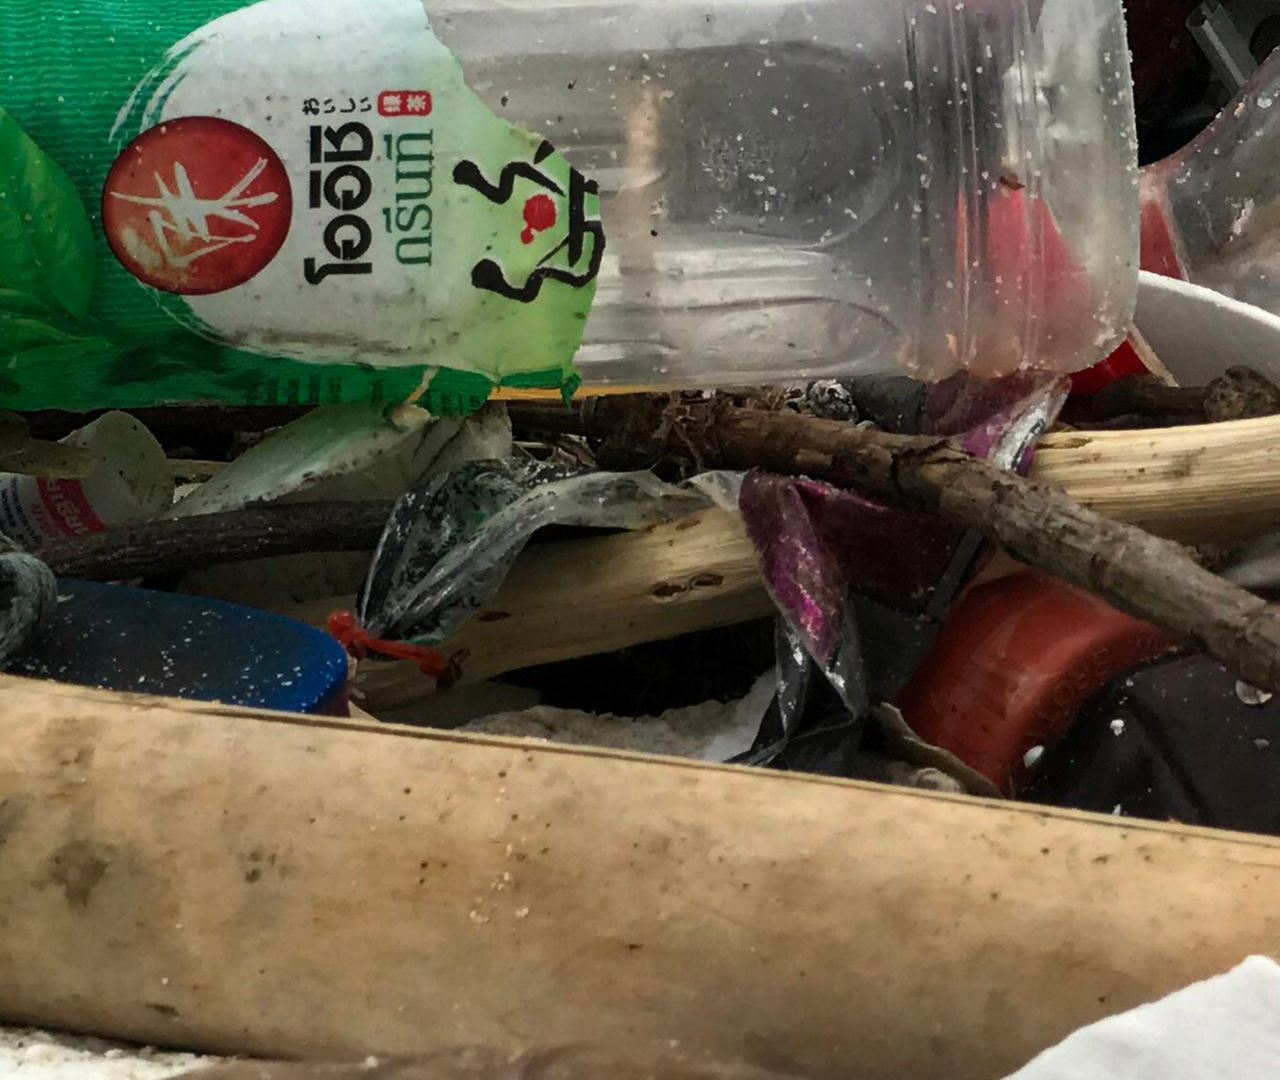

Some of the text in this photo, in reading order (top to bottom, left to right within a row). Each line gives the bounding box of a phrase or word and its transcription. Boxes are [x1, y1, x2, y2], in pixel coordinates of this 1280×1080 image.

[302, 97, 371, 115] おいしい
[304, 122, 373, 285] โออิชิ
[383, 129, 433, 266] กรีนที
